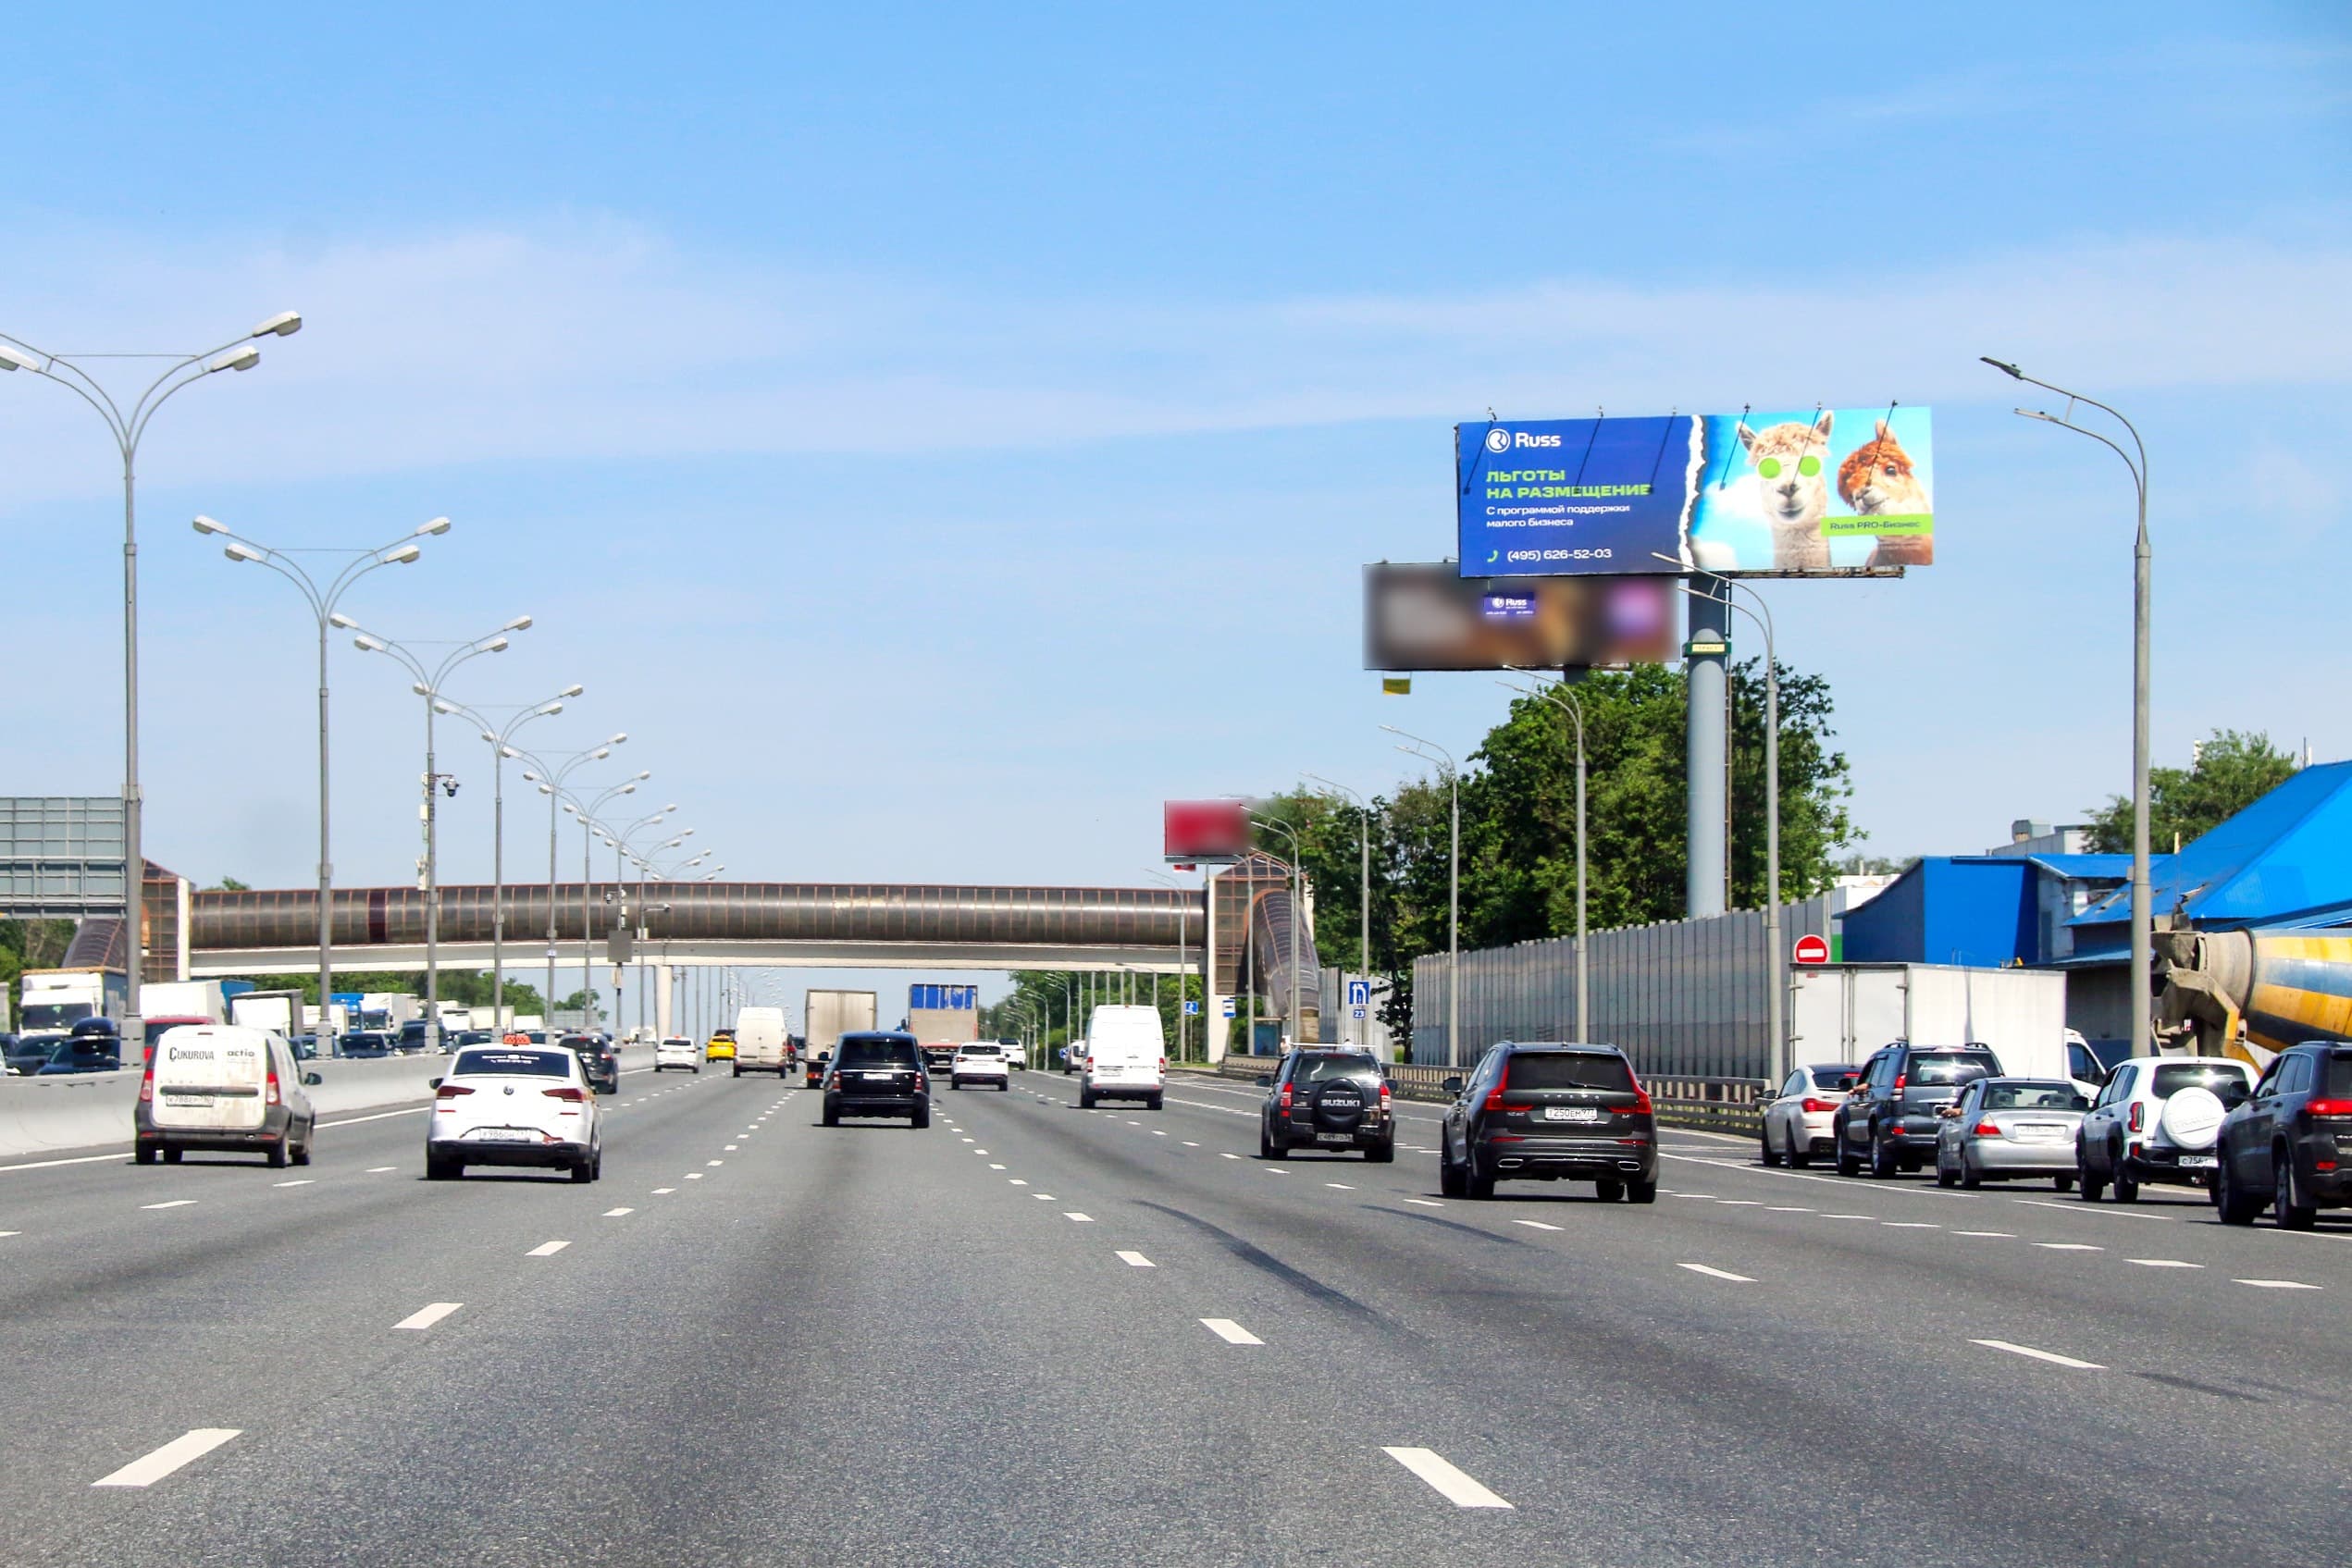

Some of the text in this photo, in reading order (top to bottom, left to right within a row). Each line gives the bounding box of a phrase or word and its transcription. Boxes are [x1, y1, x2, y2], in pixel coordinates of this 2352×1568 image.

[1515, 432, 1562, 448] Russ
[1486, 470, 1566, 483] ЛЬГОТЫ
[1487, 484, 1652, 499] НА РАЗМЕЩЕНИЕ
[1486, 504, 1630, 517] С программой поддержки
[1486, 517, 1574, 528] малого бизнеса
[1507, 549, 1612, 562] (495) 626-52-03
[169, 1046, 215, 1062] ÇUKUROVA
[1320, 1099, 1360, 1107] SUZUKI
